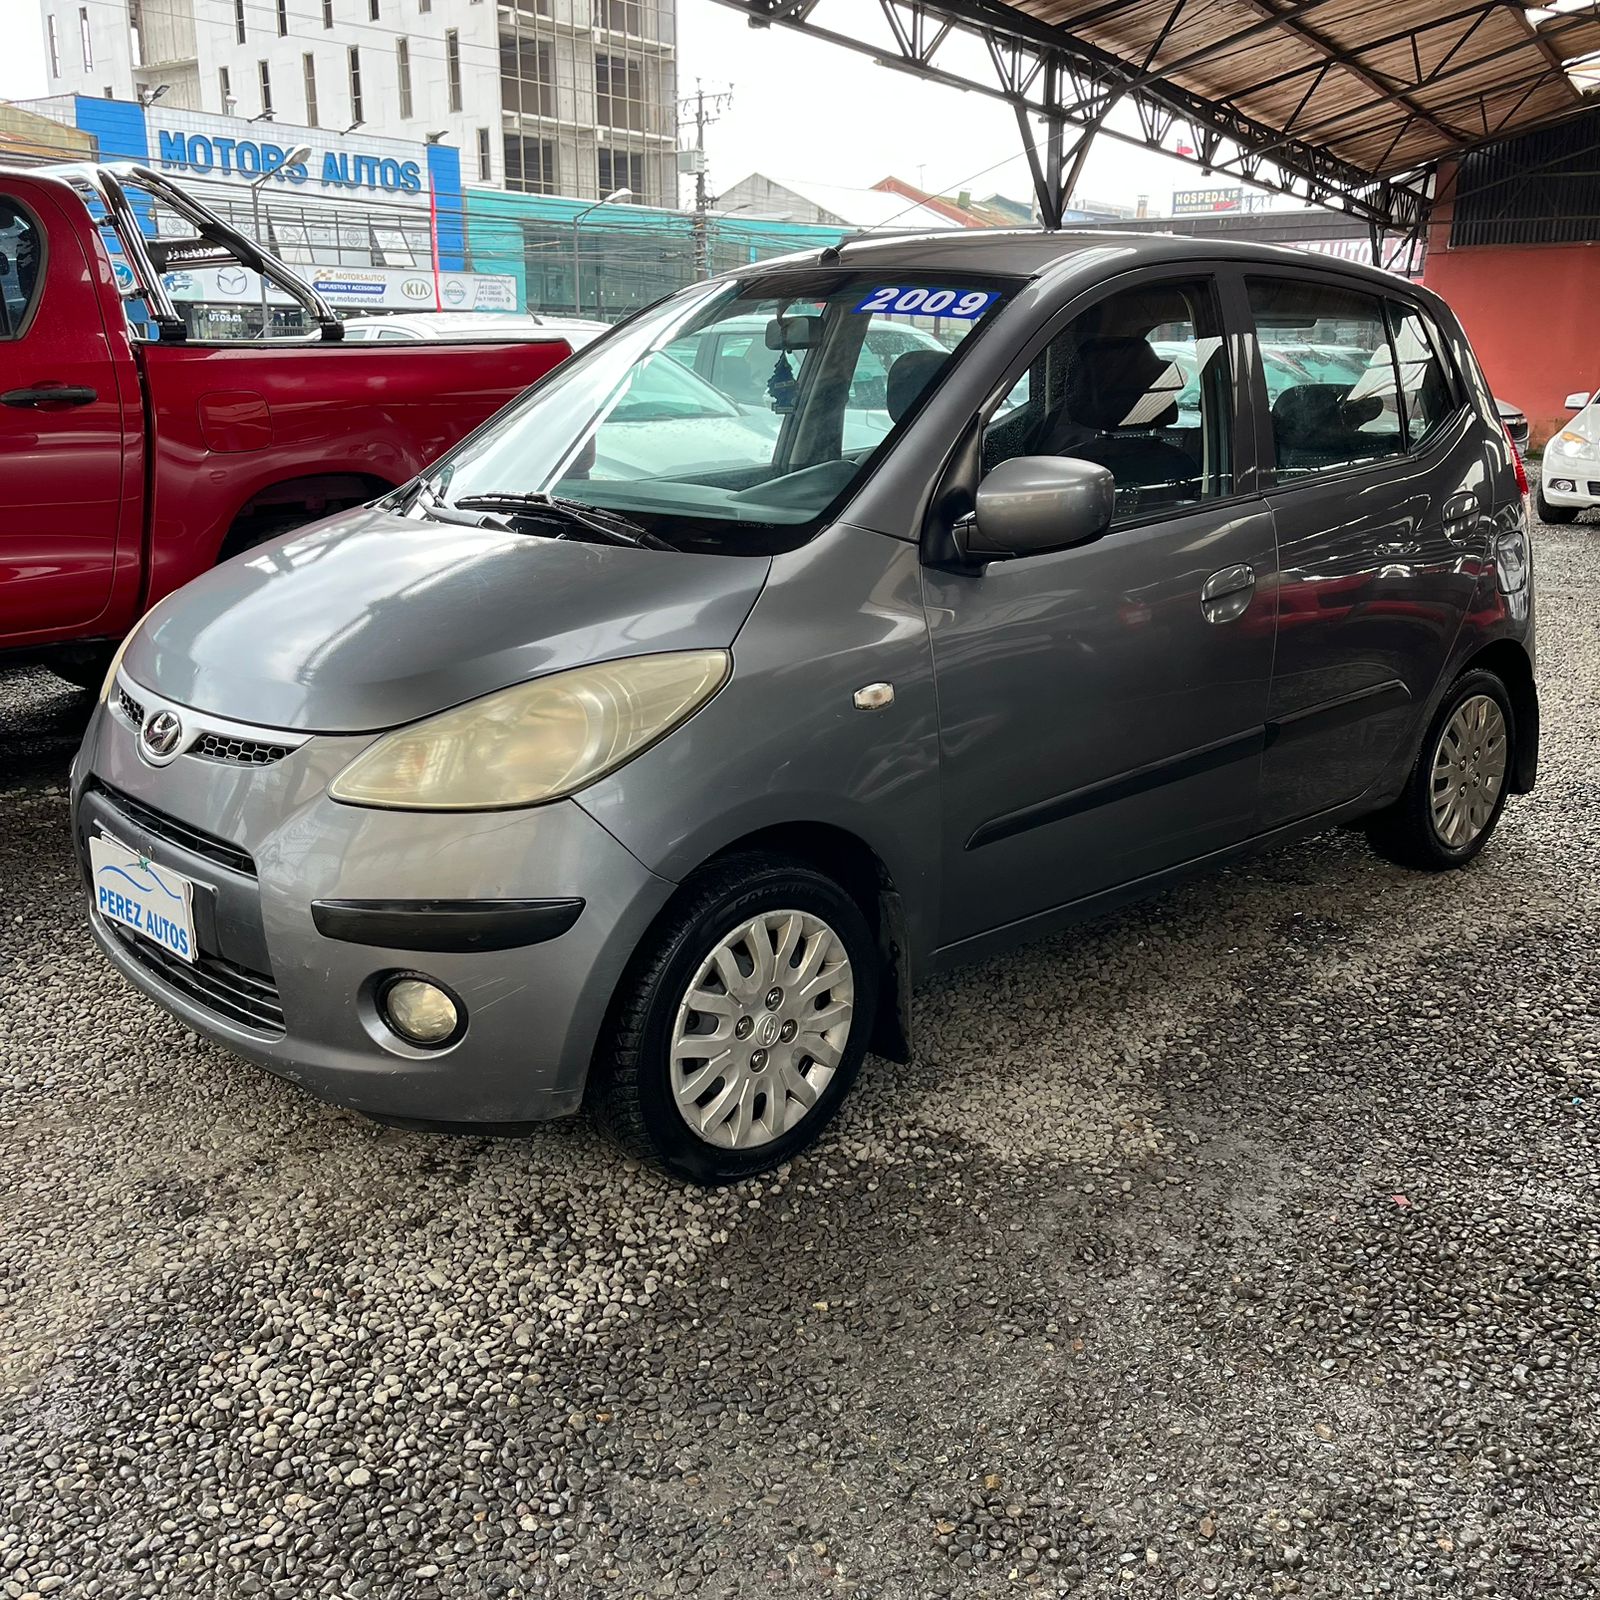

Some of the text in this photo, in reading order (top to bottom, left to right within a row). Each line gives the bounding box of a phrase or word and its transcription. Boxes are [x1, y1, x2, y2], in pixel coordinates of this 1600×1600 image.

[159, 130, 421, 195] MOTORS AUTOS
[335, 272, 386, 282] MOTORSAUTOS
[406, 285, 428, 297] KIA
[861, 288, 988, 315] 2009
[99, 886, 188, 955] PEREZ AUTOS
